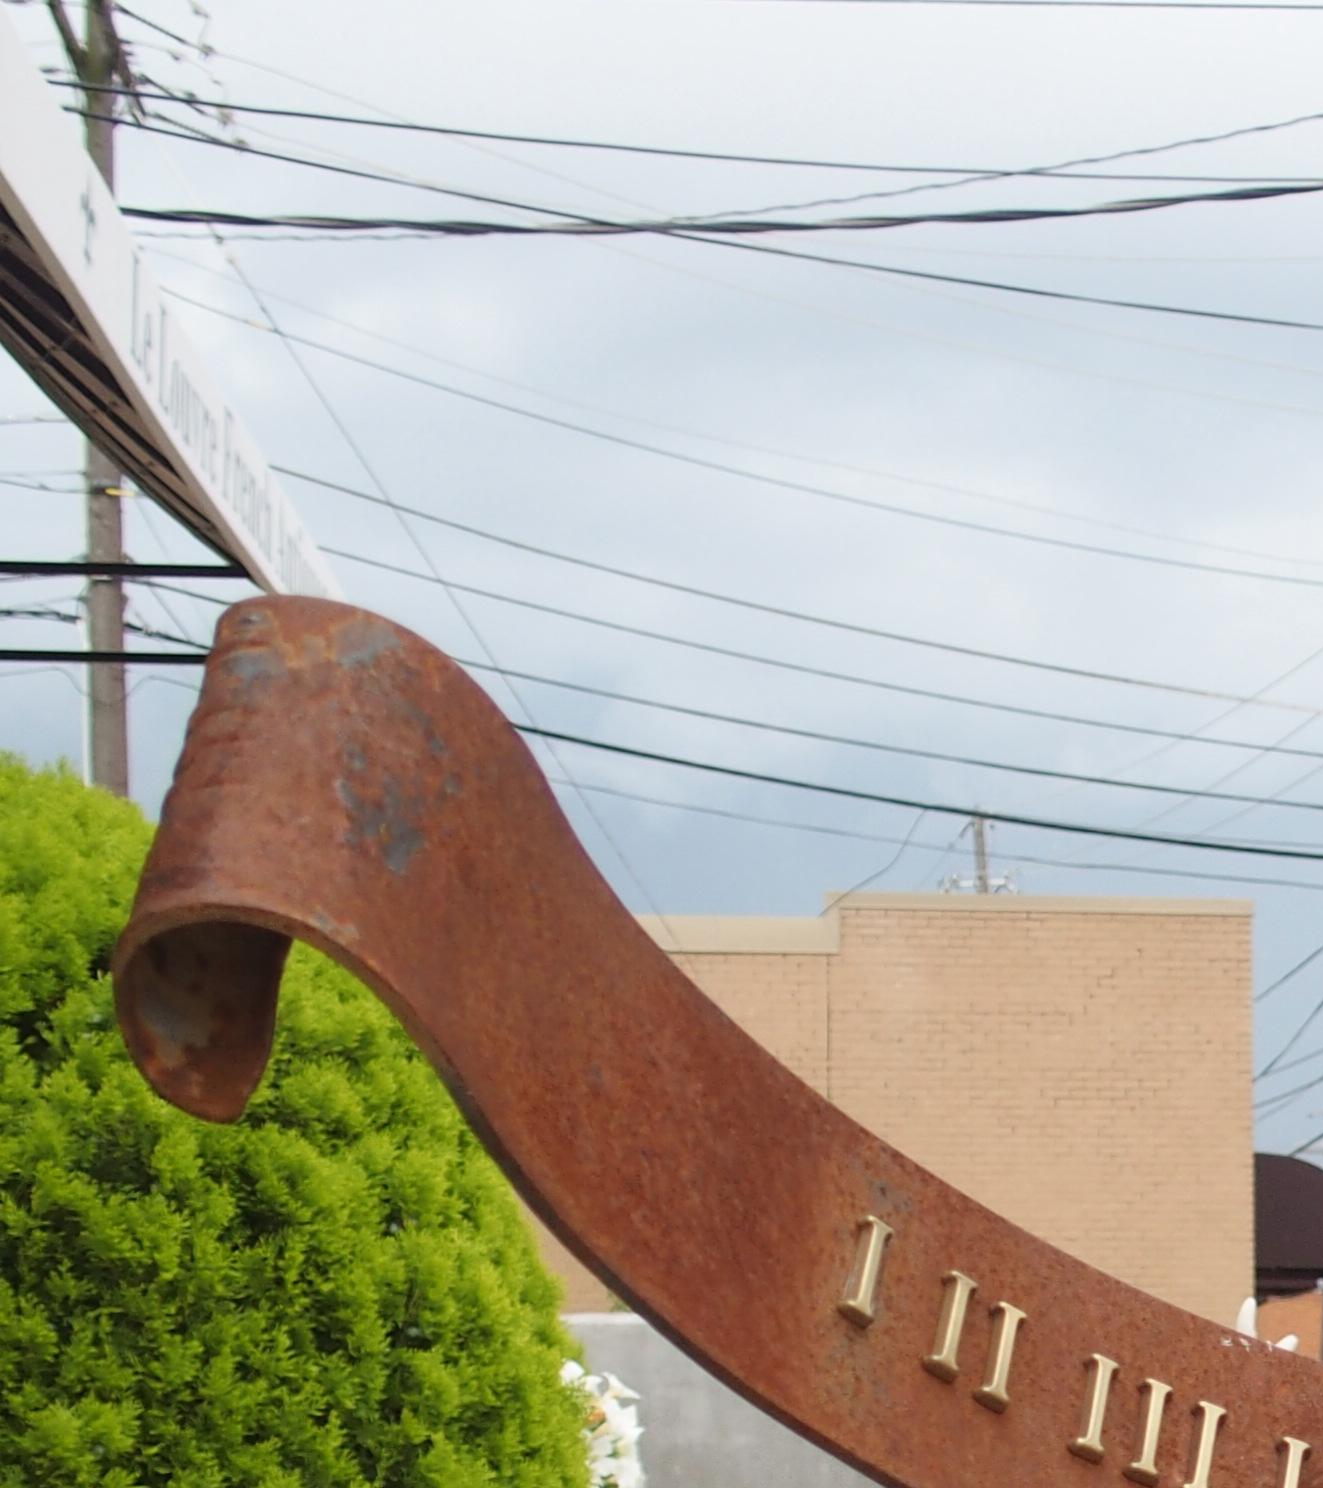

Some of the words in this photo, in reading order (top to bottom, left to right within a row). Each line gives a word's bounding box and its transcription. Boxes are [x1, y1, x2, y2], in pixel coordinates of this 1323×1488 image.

[130, 251, 153, 386] Le
[158, 302, 218, 484] Louvre
[838, 1215, 893, 1328] I
[922, 1270, 1027, 1413] II
